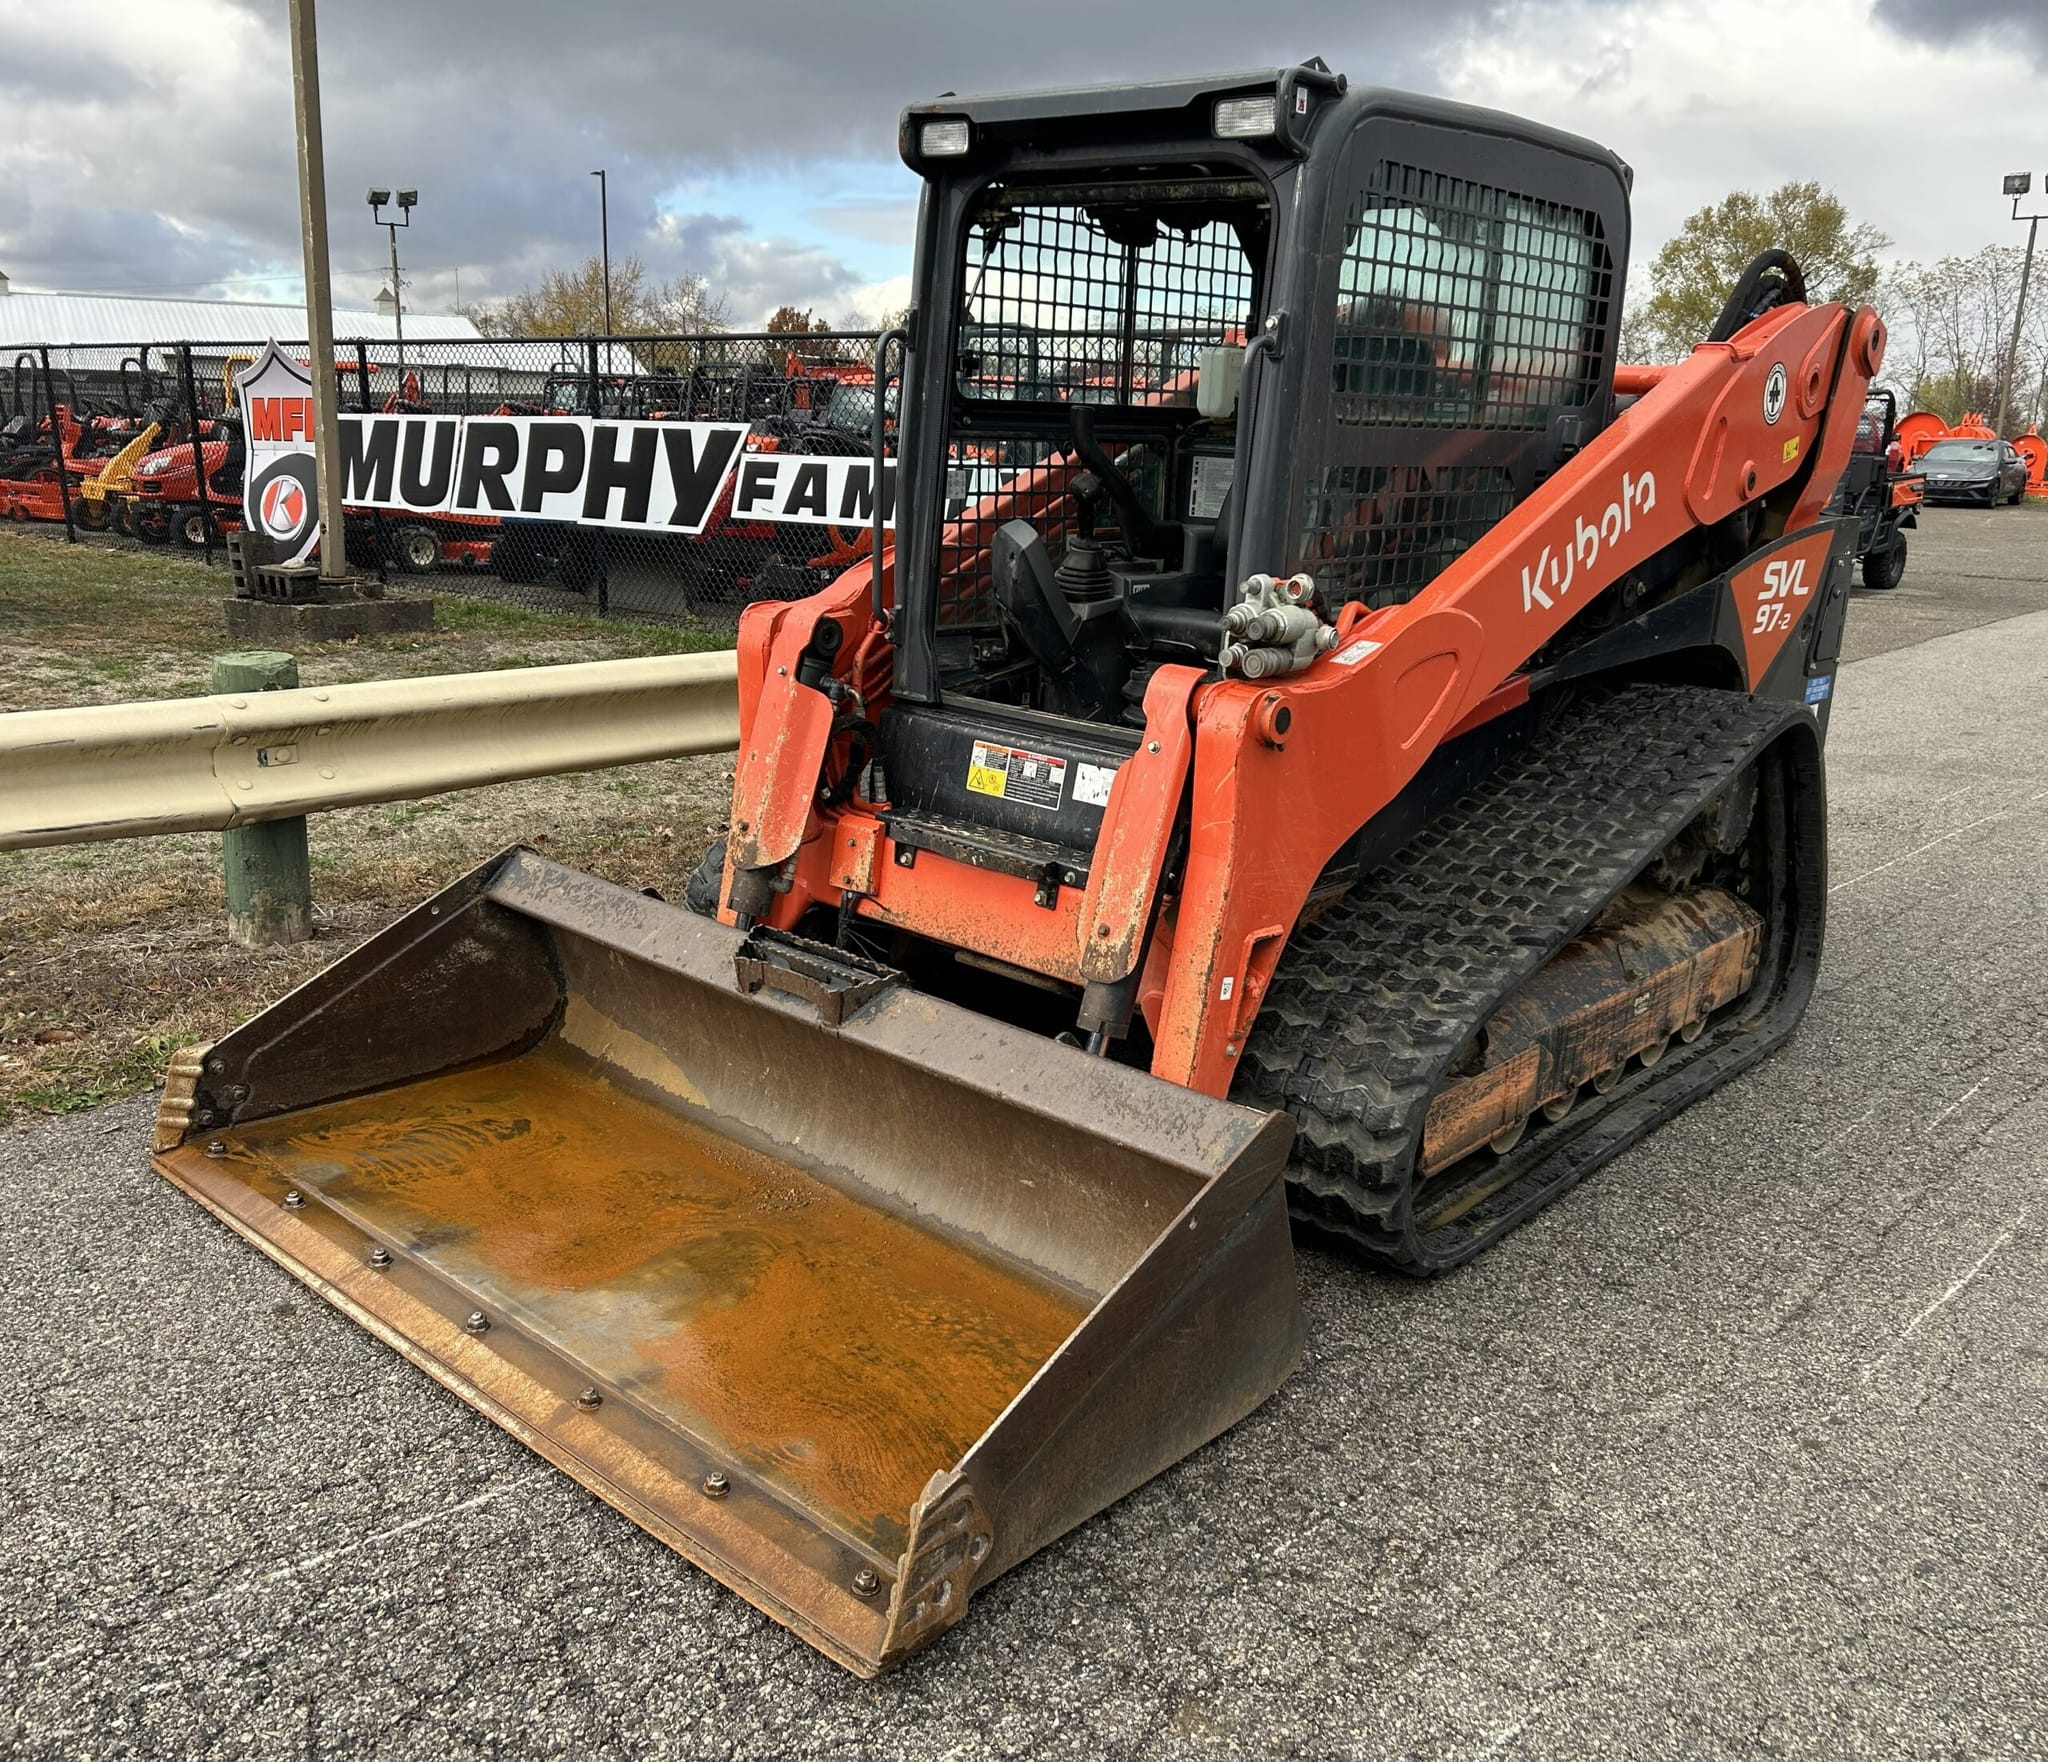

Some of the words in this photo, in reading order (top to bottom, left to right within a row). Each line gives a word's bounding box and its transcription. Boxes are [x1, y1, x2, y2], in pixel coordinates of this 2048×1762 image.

[338, 419, 742, 528] MURPHY
[738, 461, 897, 521] FAM
[1521, 471, 1656, 614] Kubota
[1757, 558, 1810, 601] SVL
